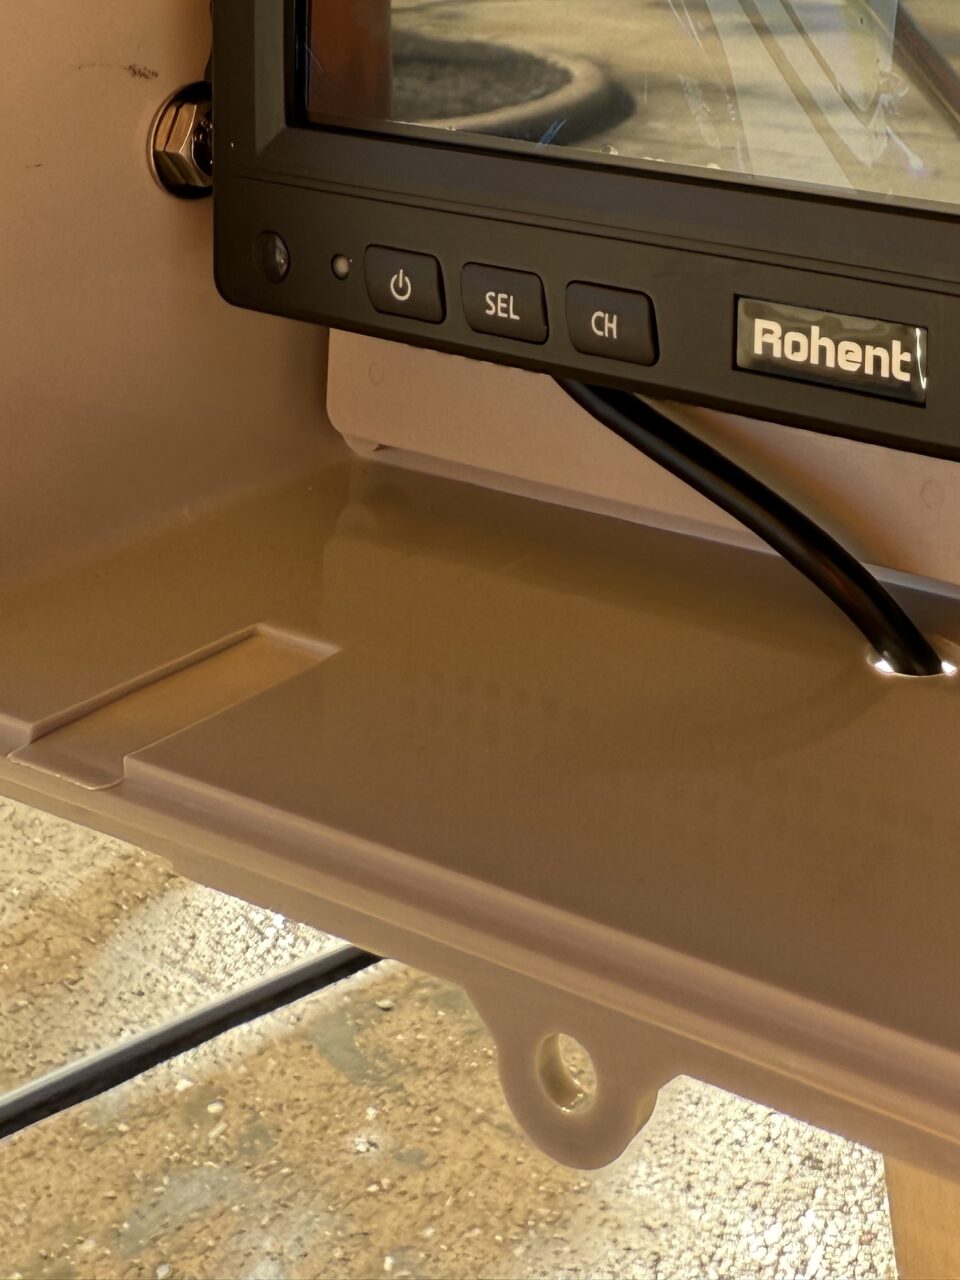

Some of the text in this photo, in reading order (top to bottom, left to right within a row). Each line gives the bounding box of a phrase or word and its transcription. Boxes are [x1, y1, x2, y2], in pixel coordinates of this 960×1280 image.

[486, 292, 519, 320] SEL
[592, 311, 617, 338] CH
[754, 319, 911, 381] Rohent
